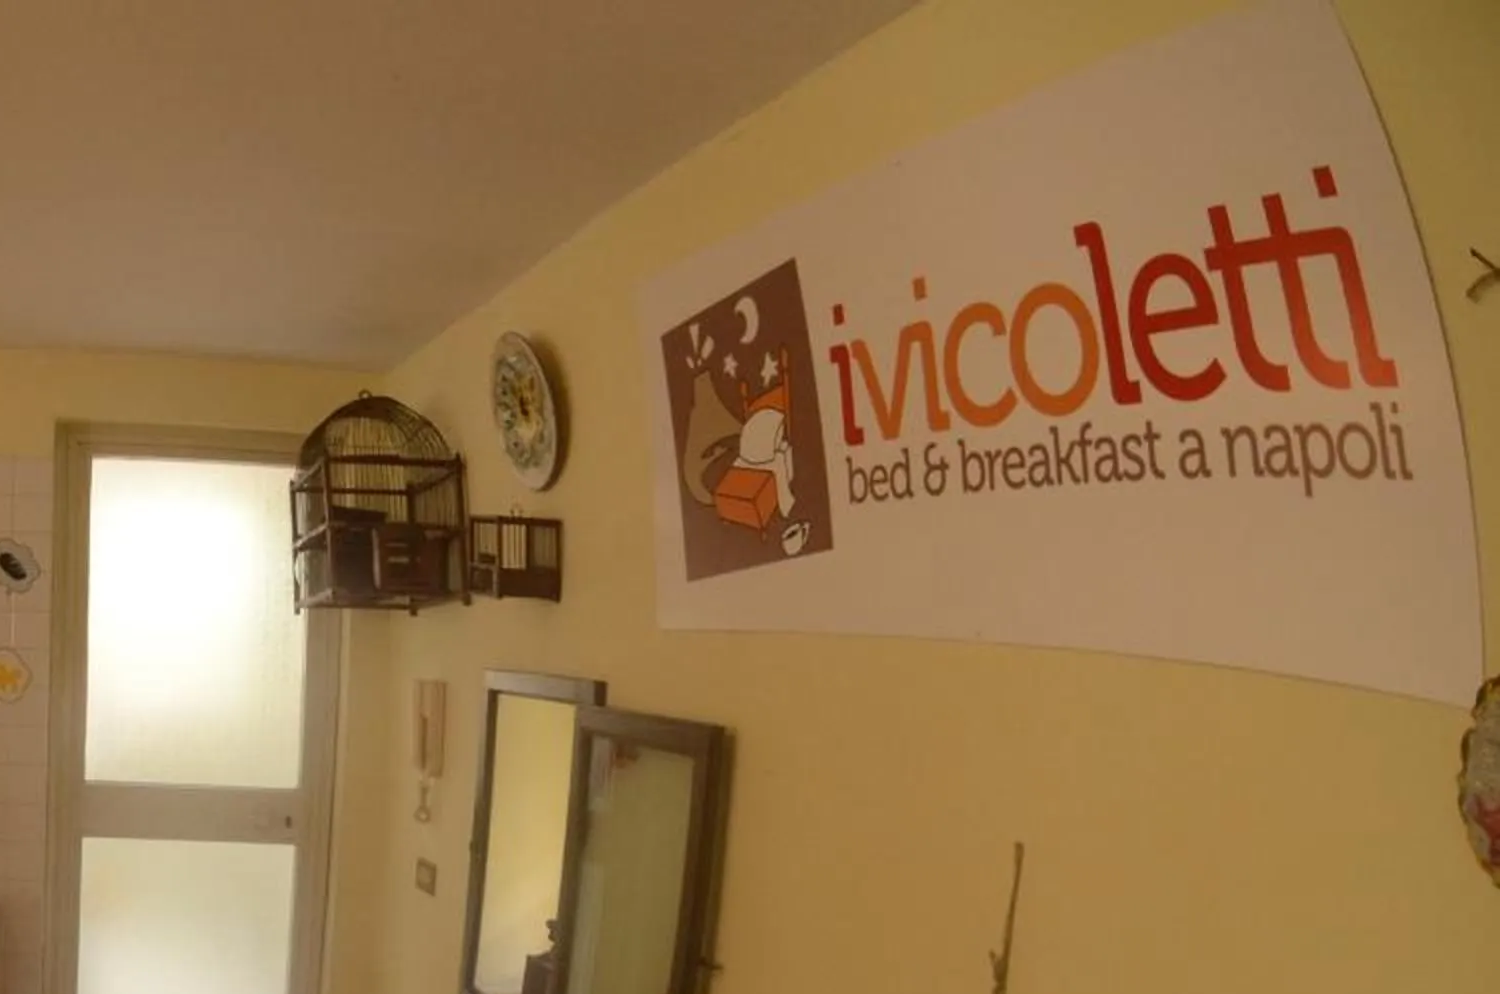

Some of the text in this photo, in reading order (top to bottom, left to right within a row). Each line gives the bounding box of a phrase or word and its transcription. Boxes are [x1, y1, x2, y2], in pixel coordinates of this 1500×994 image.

[845, 401, 1414, 504] bed & breakfast a napoli
